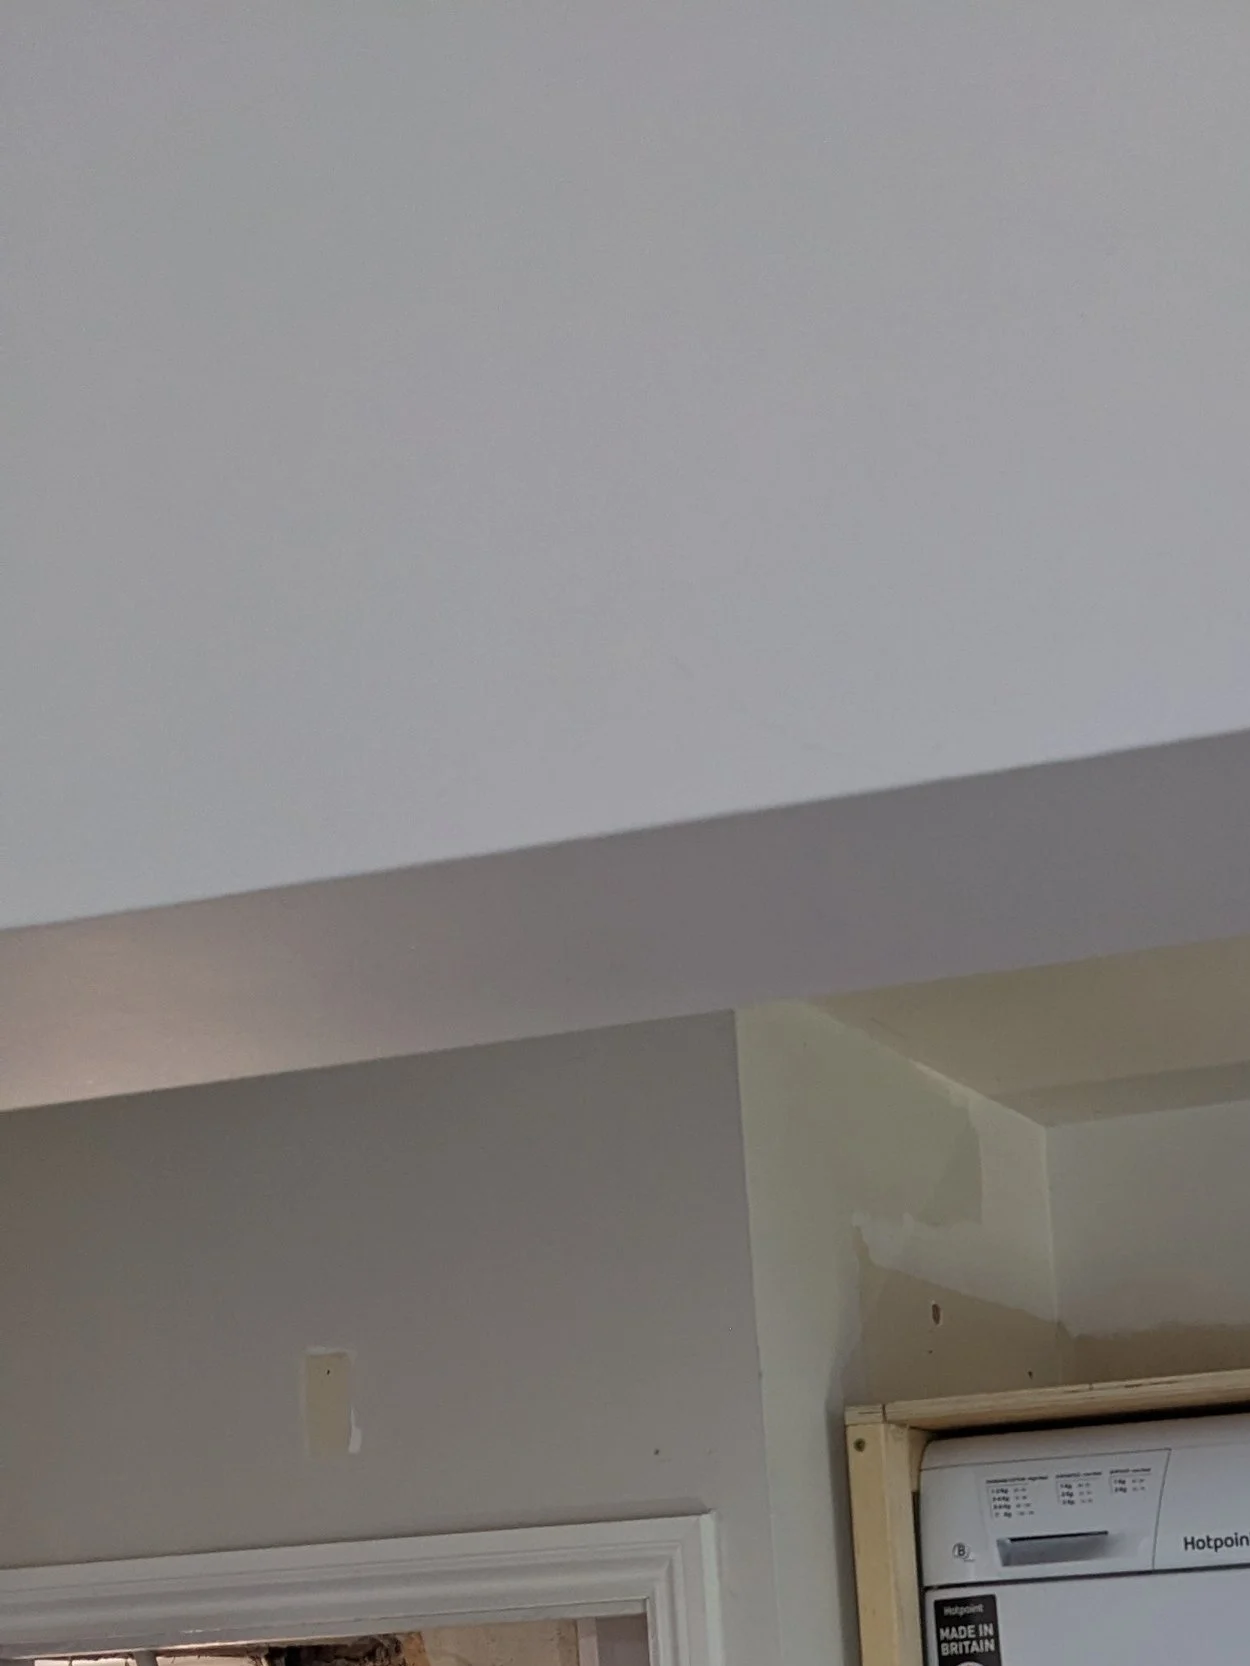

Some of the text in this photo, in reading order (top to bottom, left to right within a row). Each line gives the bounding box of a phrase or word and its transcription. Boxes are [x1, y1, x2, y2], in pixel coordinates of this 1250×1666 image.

[943, 1603, 984, 1617] Hotpoint
[940, 1622, 994, 1641] MADE IN
[941, 1638, 995, 1656] BRITAIN
